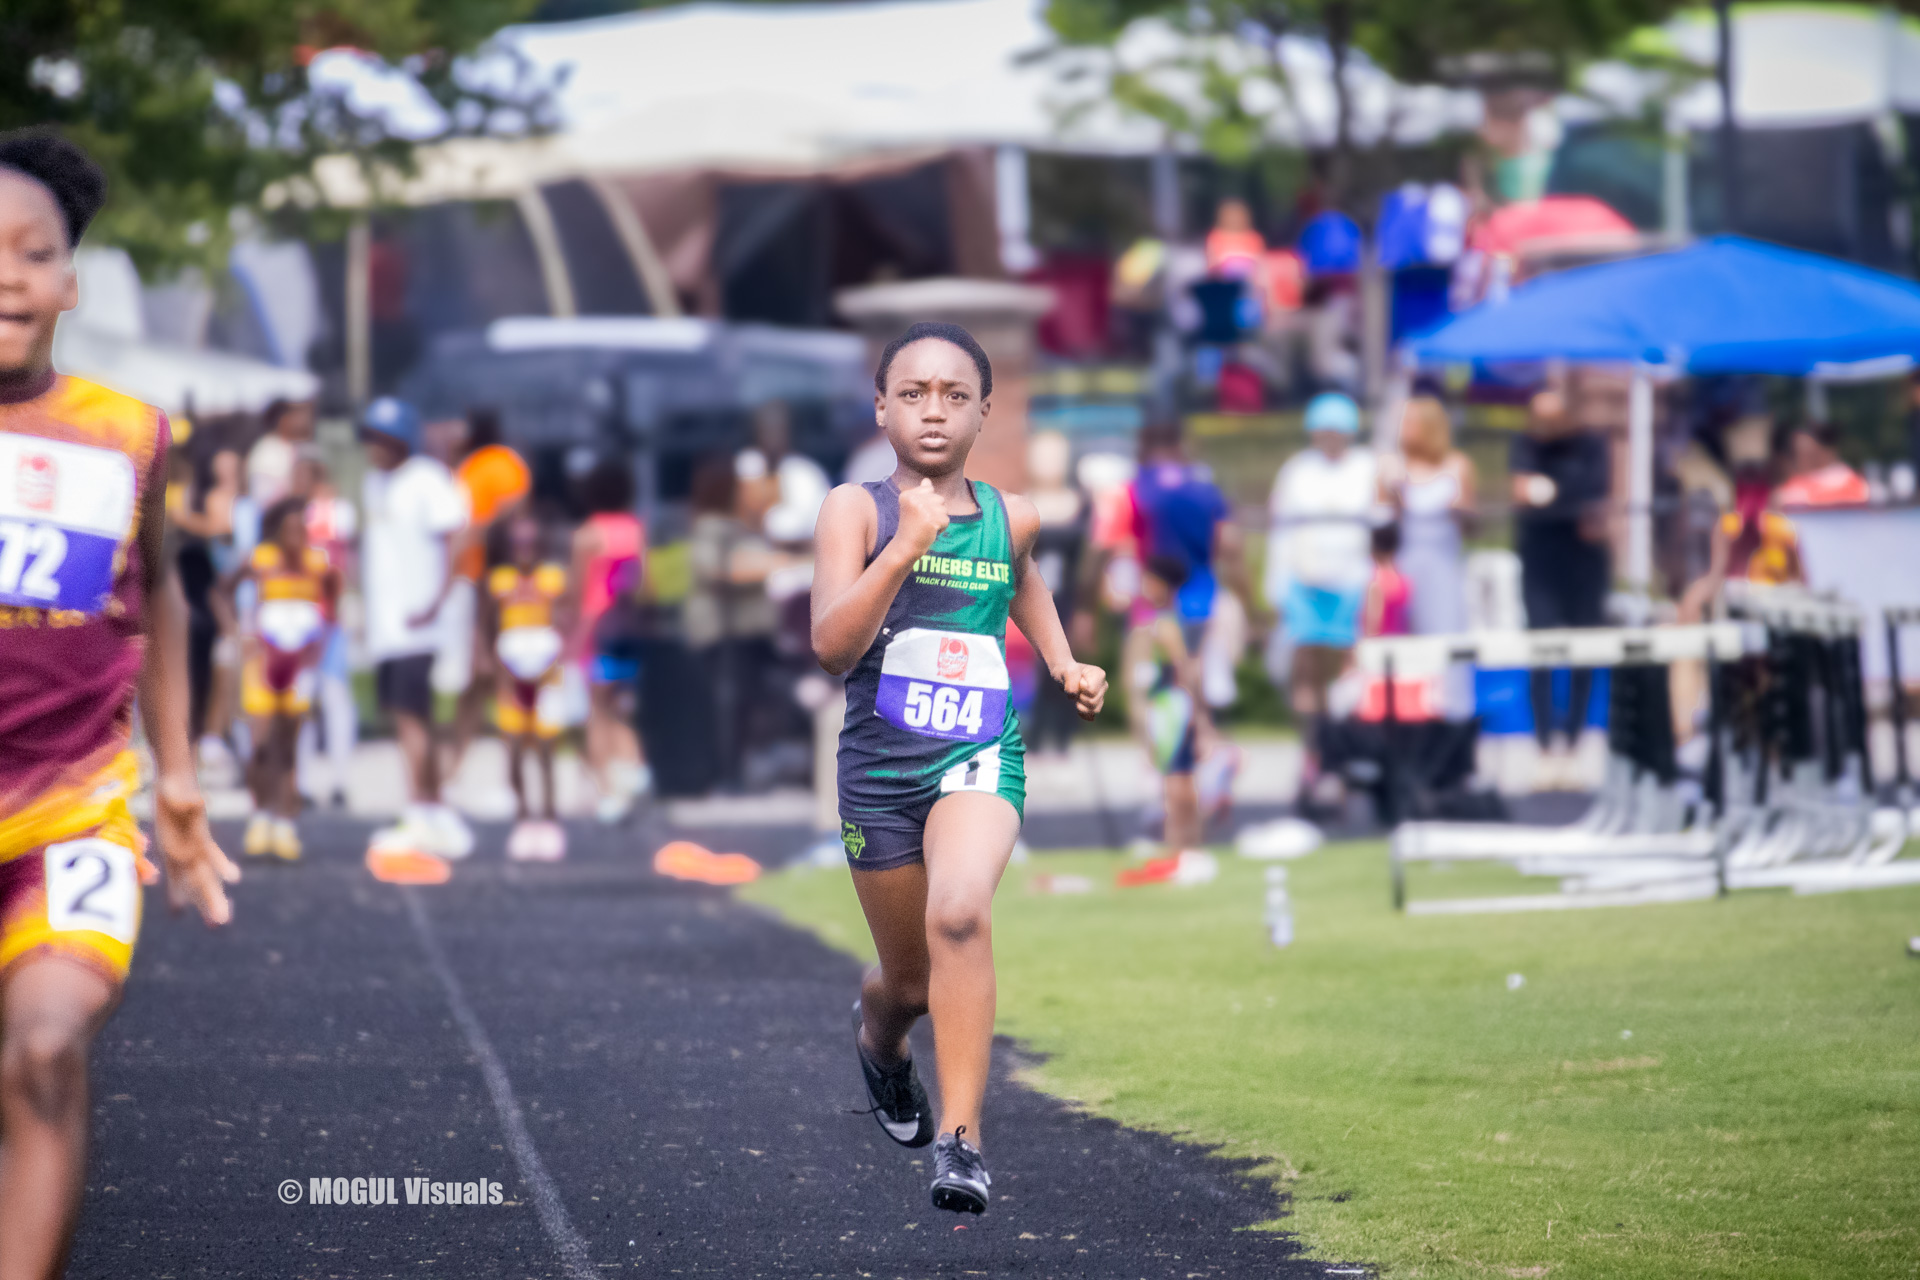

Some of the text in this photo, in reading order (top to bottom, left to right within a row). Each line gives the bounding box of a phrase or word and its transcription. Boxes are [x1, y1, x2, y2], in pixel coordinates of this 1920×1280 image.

[915, 576, 940, 586] TRACK
[947, 580, 968, 589] FIELD
[969, 582, 989, 591] CLUB
[903, 681, 983, 735] 564
[62, 849, 115, 922] 2
